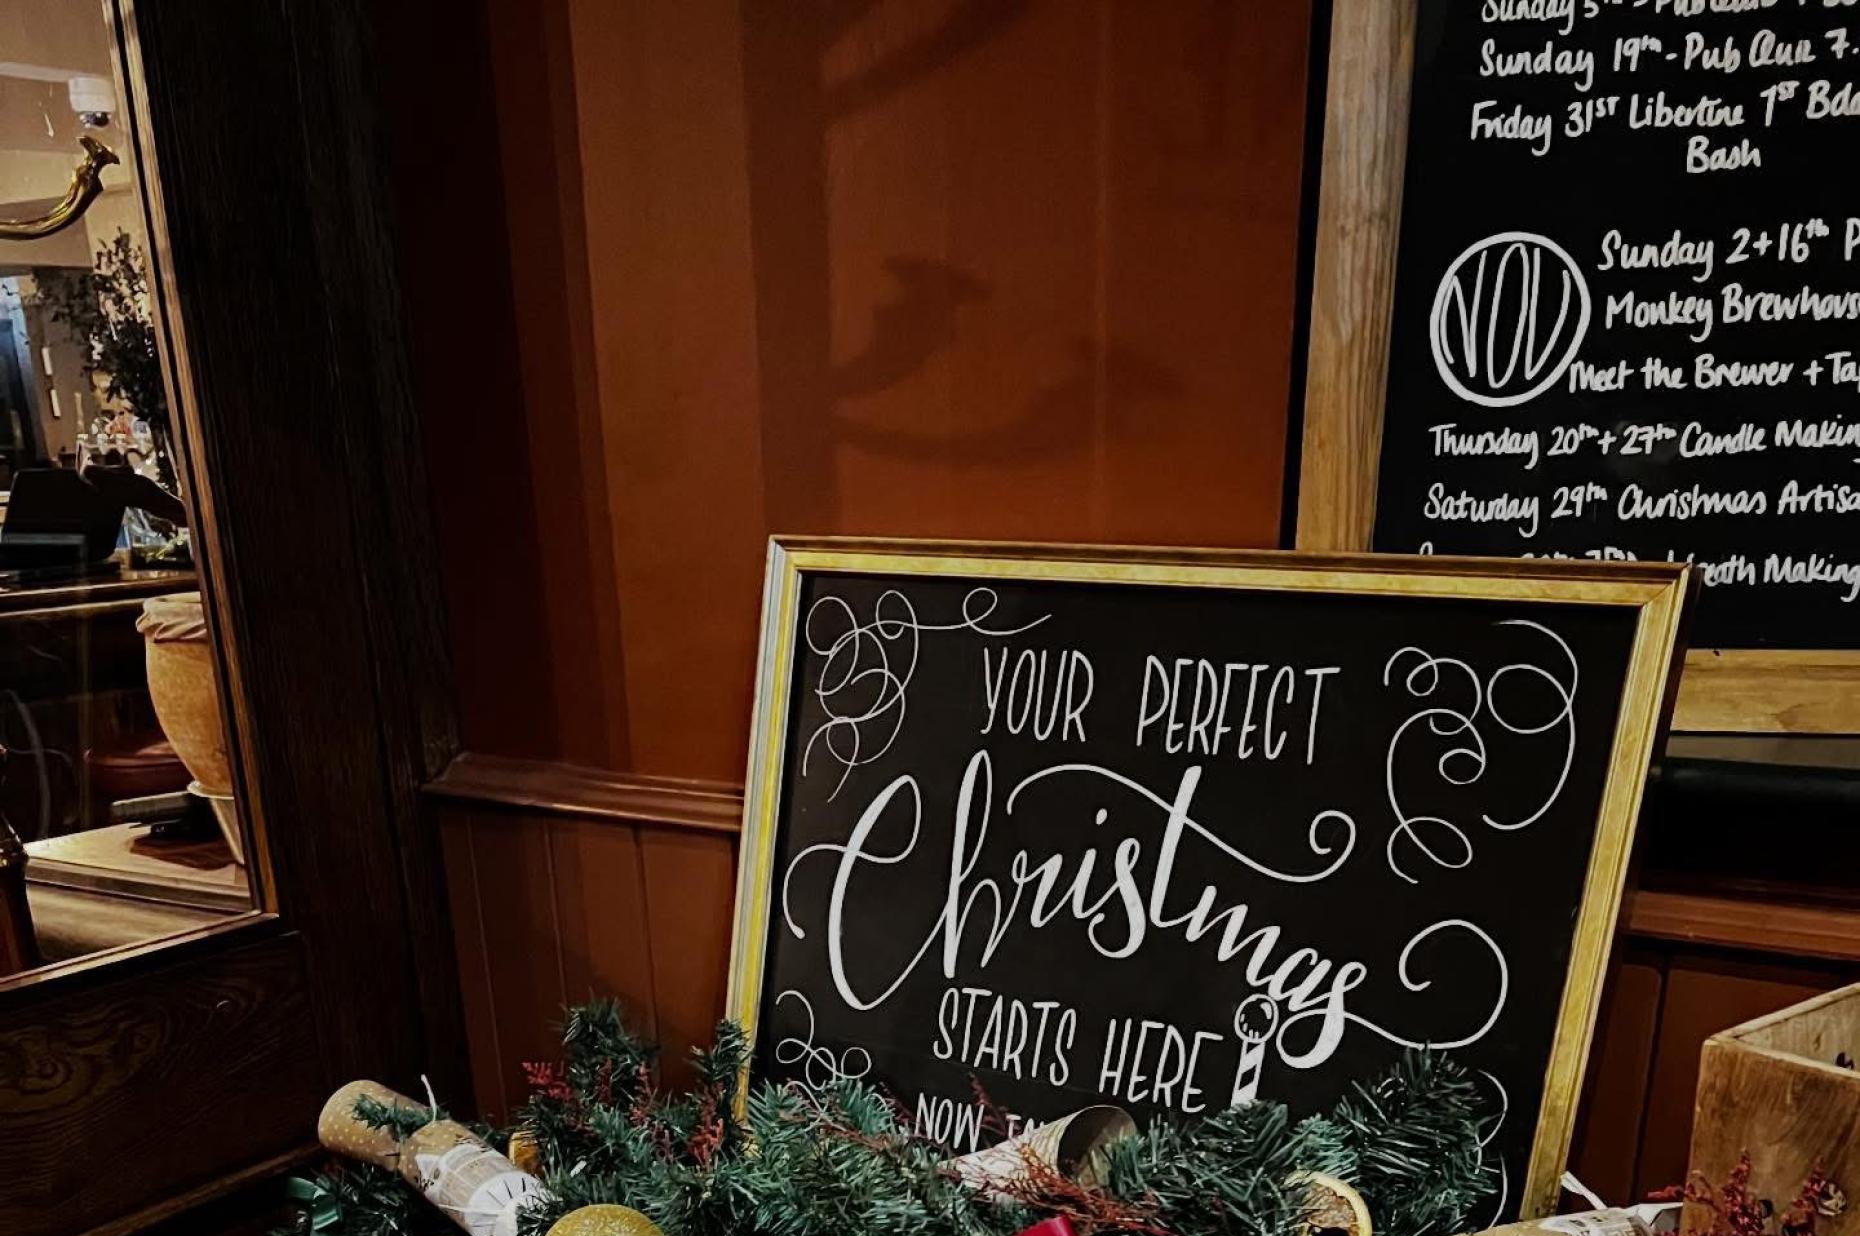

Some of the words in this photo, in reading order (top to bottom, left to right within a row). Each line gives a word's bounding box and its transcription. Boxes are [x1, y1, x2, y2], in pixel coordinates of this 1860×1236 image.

[1480, 38, 1595, 92] Sunday
[1684, 31, 1741, 73] Pub
[1470, 100, 1552, 156] Friday
[1629, 91, 1745, 129] Libertine
[1687, 135, 1762, 173] Bash
[1598, 229, 1714, 283] Sunday
[1605, 290, 1713, 343] Monkey
[1569, 360, 1634, 393] Meet
[1640, 357, 1688, 389] the
[1695, 353, 1795, 389] Brewer
[1428, 423, 1539, 470] Thursday
[1679, 421, 1767, 458] Candle
[1774, 413, 1860, 464] Makin
[1423, 482, 1539, 538] Saturday
[1763, 553, 1860, 602] Making
[980, 647, 1095, 743] YOUR
[1137, 655, 1342, 765] PERFECT
[784, 750, 1368, 1069] Christmas
[932, 987, 1076, 1087] STARTS
[1099, 1018, 1224, 1114] HERE
[914, 1091, 985, 1153] NOW
